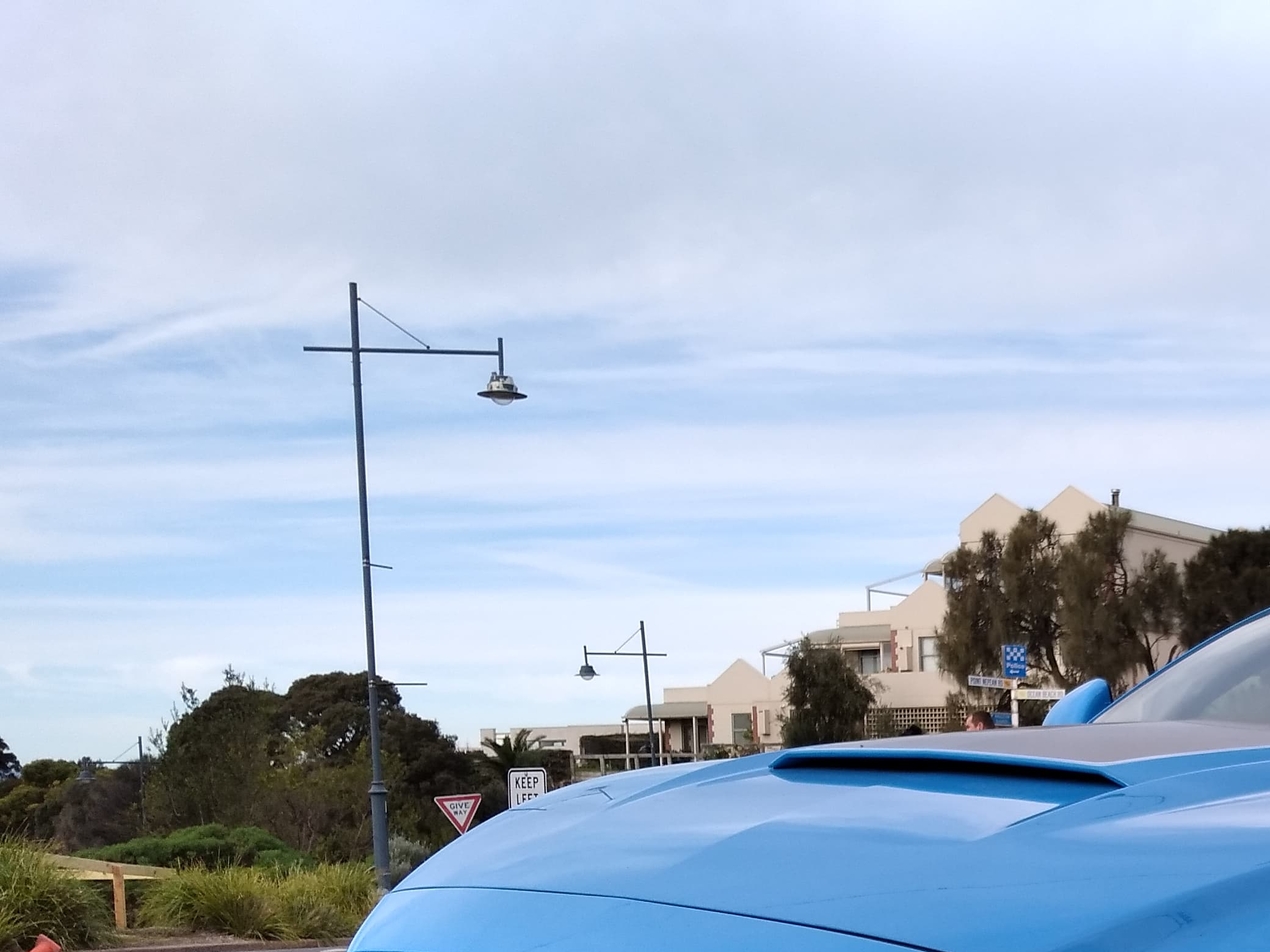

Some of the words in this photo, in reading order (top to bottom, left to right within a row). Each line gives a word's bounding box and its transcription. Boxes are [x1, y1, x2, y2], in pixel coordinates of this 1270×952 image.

[1027, 690, 1041, 698] OCEAN
[1042, 690, 1056, 698] BEACH
[515, 776, 539, 789] KEEP
[449, 802, 470, 810] GIVE
